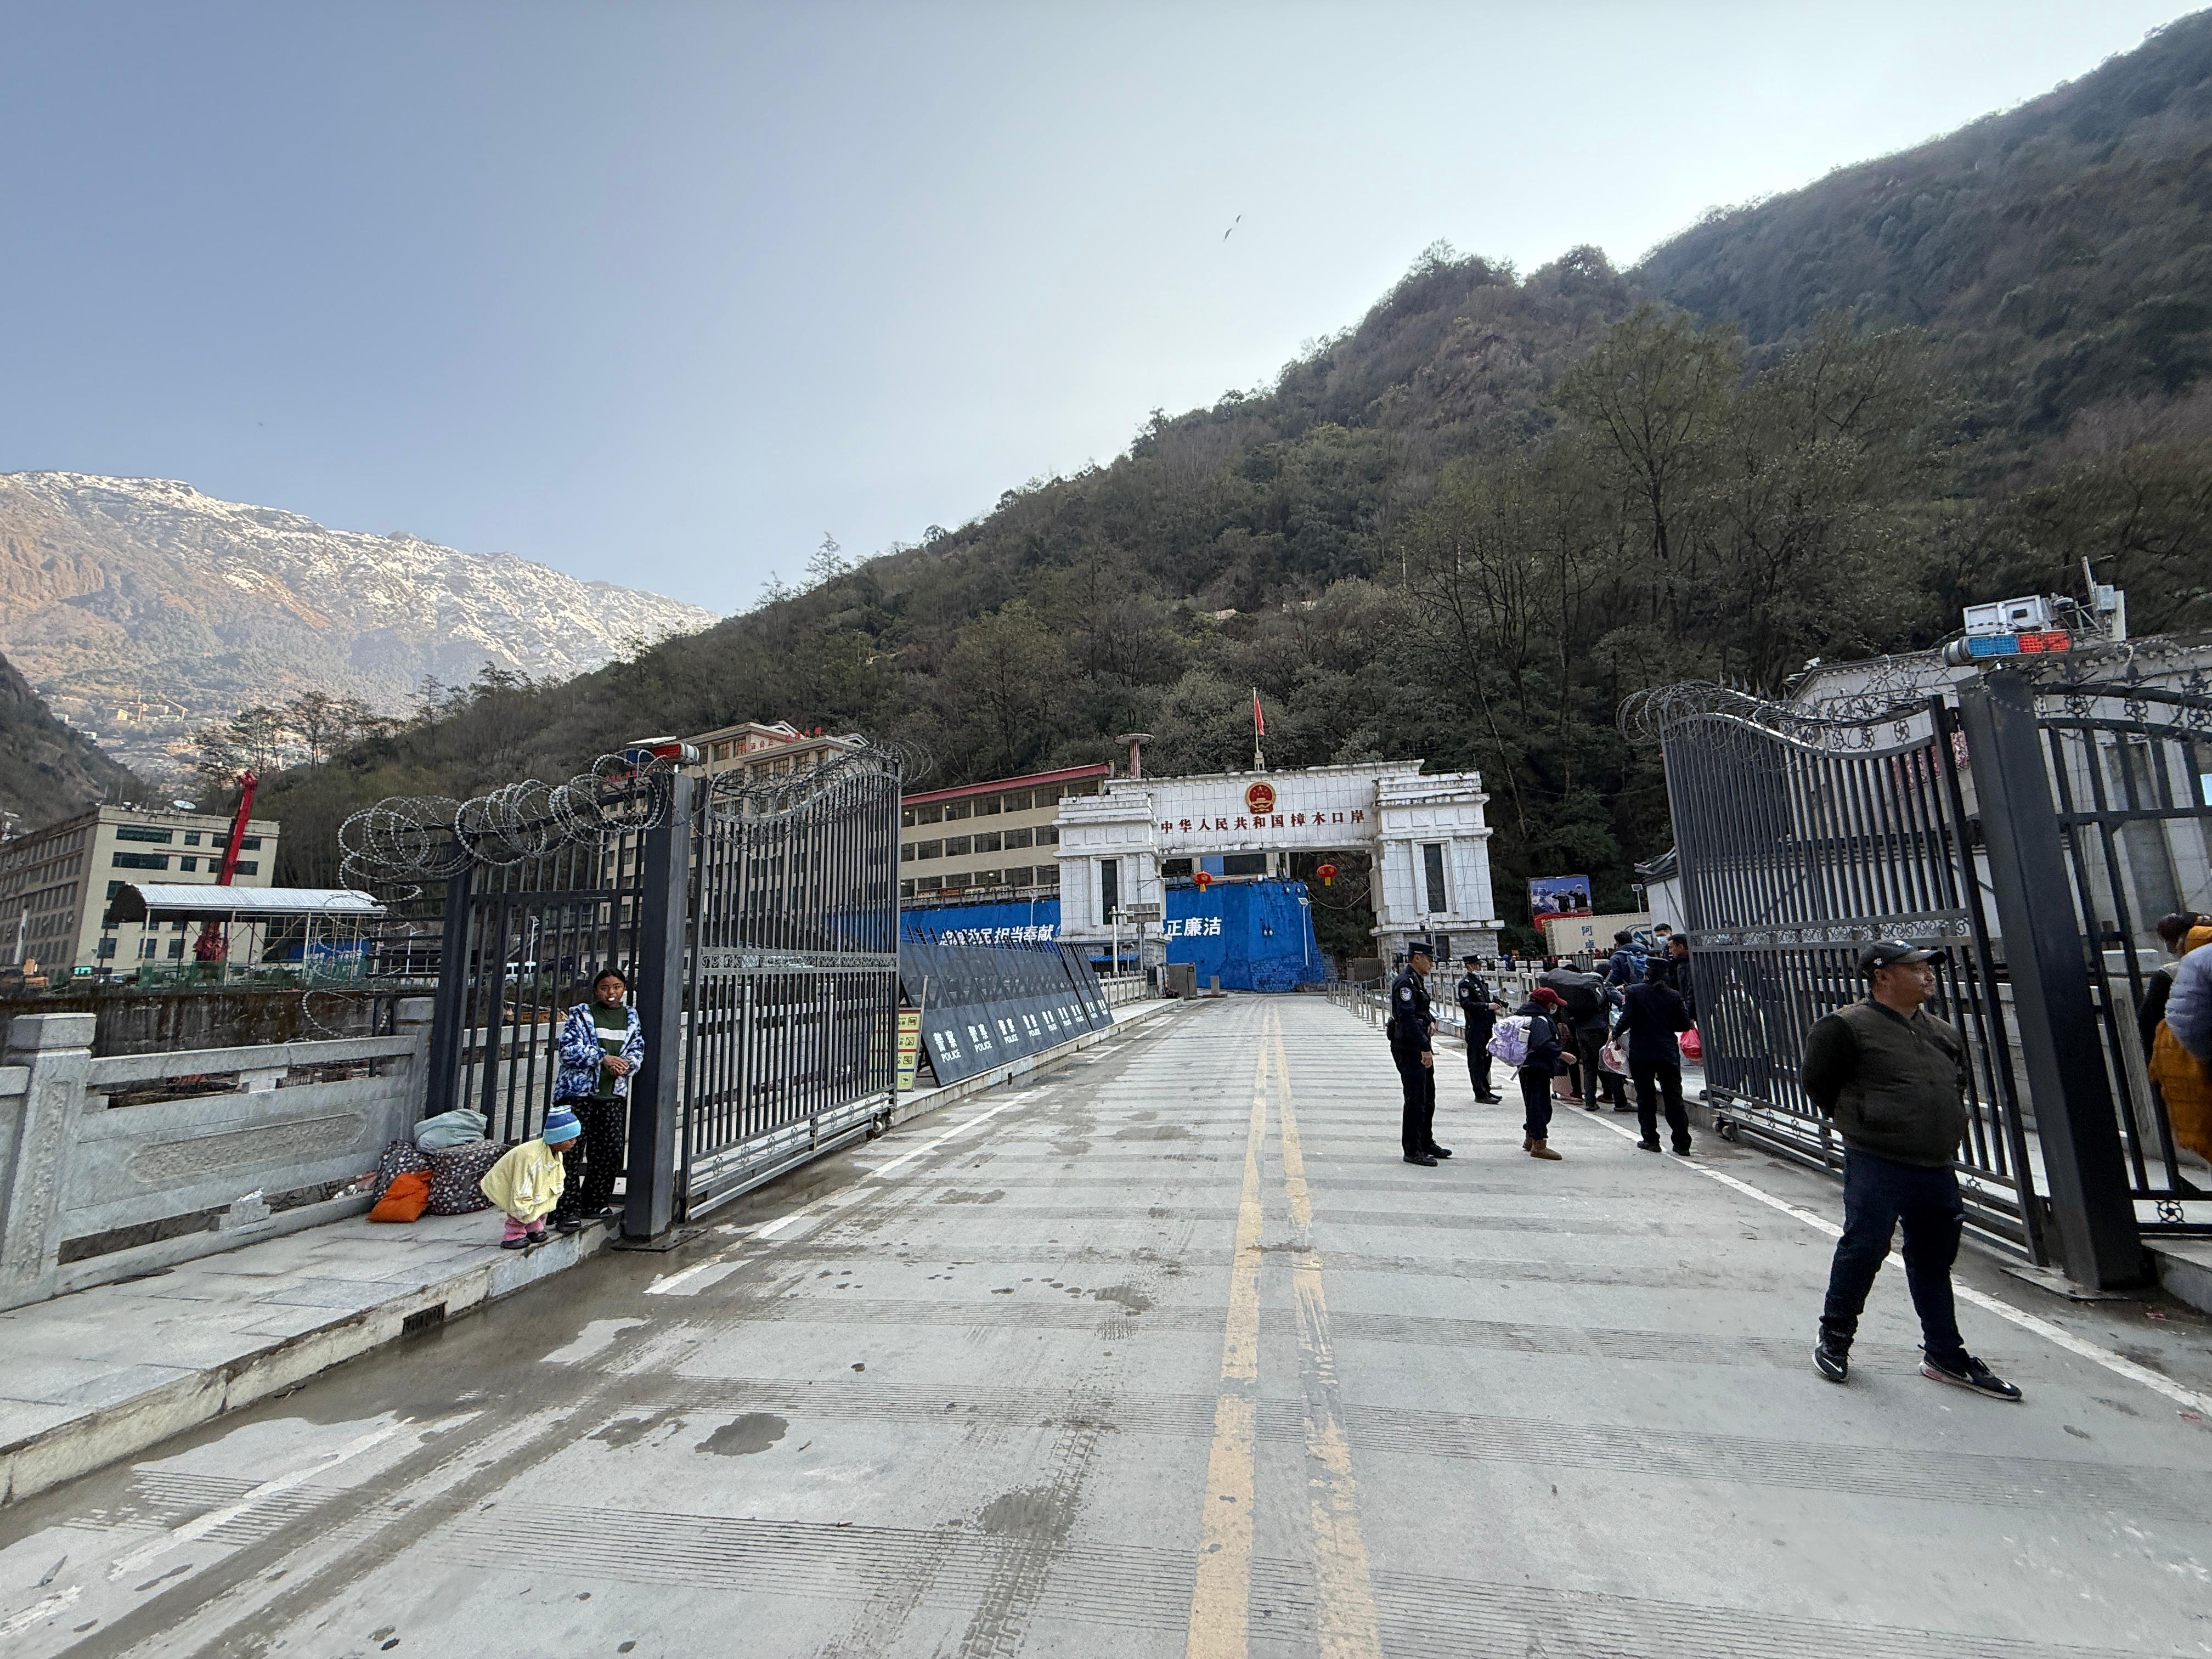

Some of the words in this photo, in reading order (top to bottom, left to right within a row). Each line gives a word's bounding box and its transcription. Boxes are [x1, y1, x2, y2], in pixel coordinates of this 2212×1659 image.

[1161, 809, 1365, 834] 中华人民共和国樟木口岸
[994, 924, 1054, 945] 担当奉献
[1163, 917, 1222, 936] 正廉洁
[1004, 1034, 1019, 1044] POLICE
[974, 1041, 992, 1053] POLICE
[941, 1049, 961, 1063] POLICE
